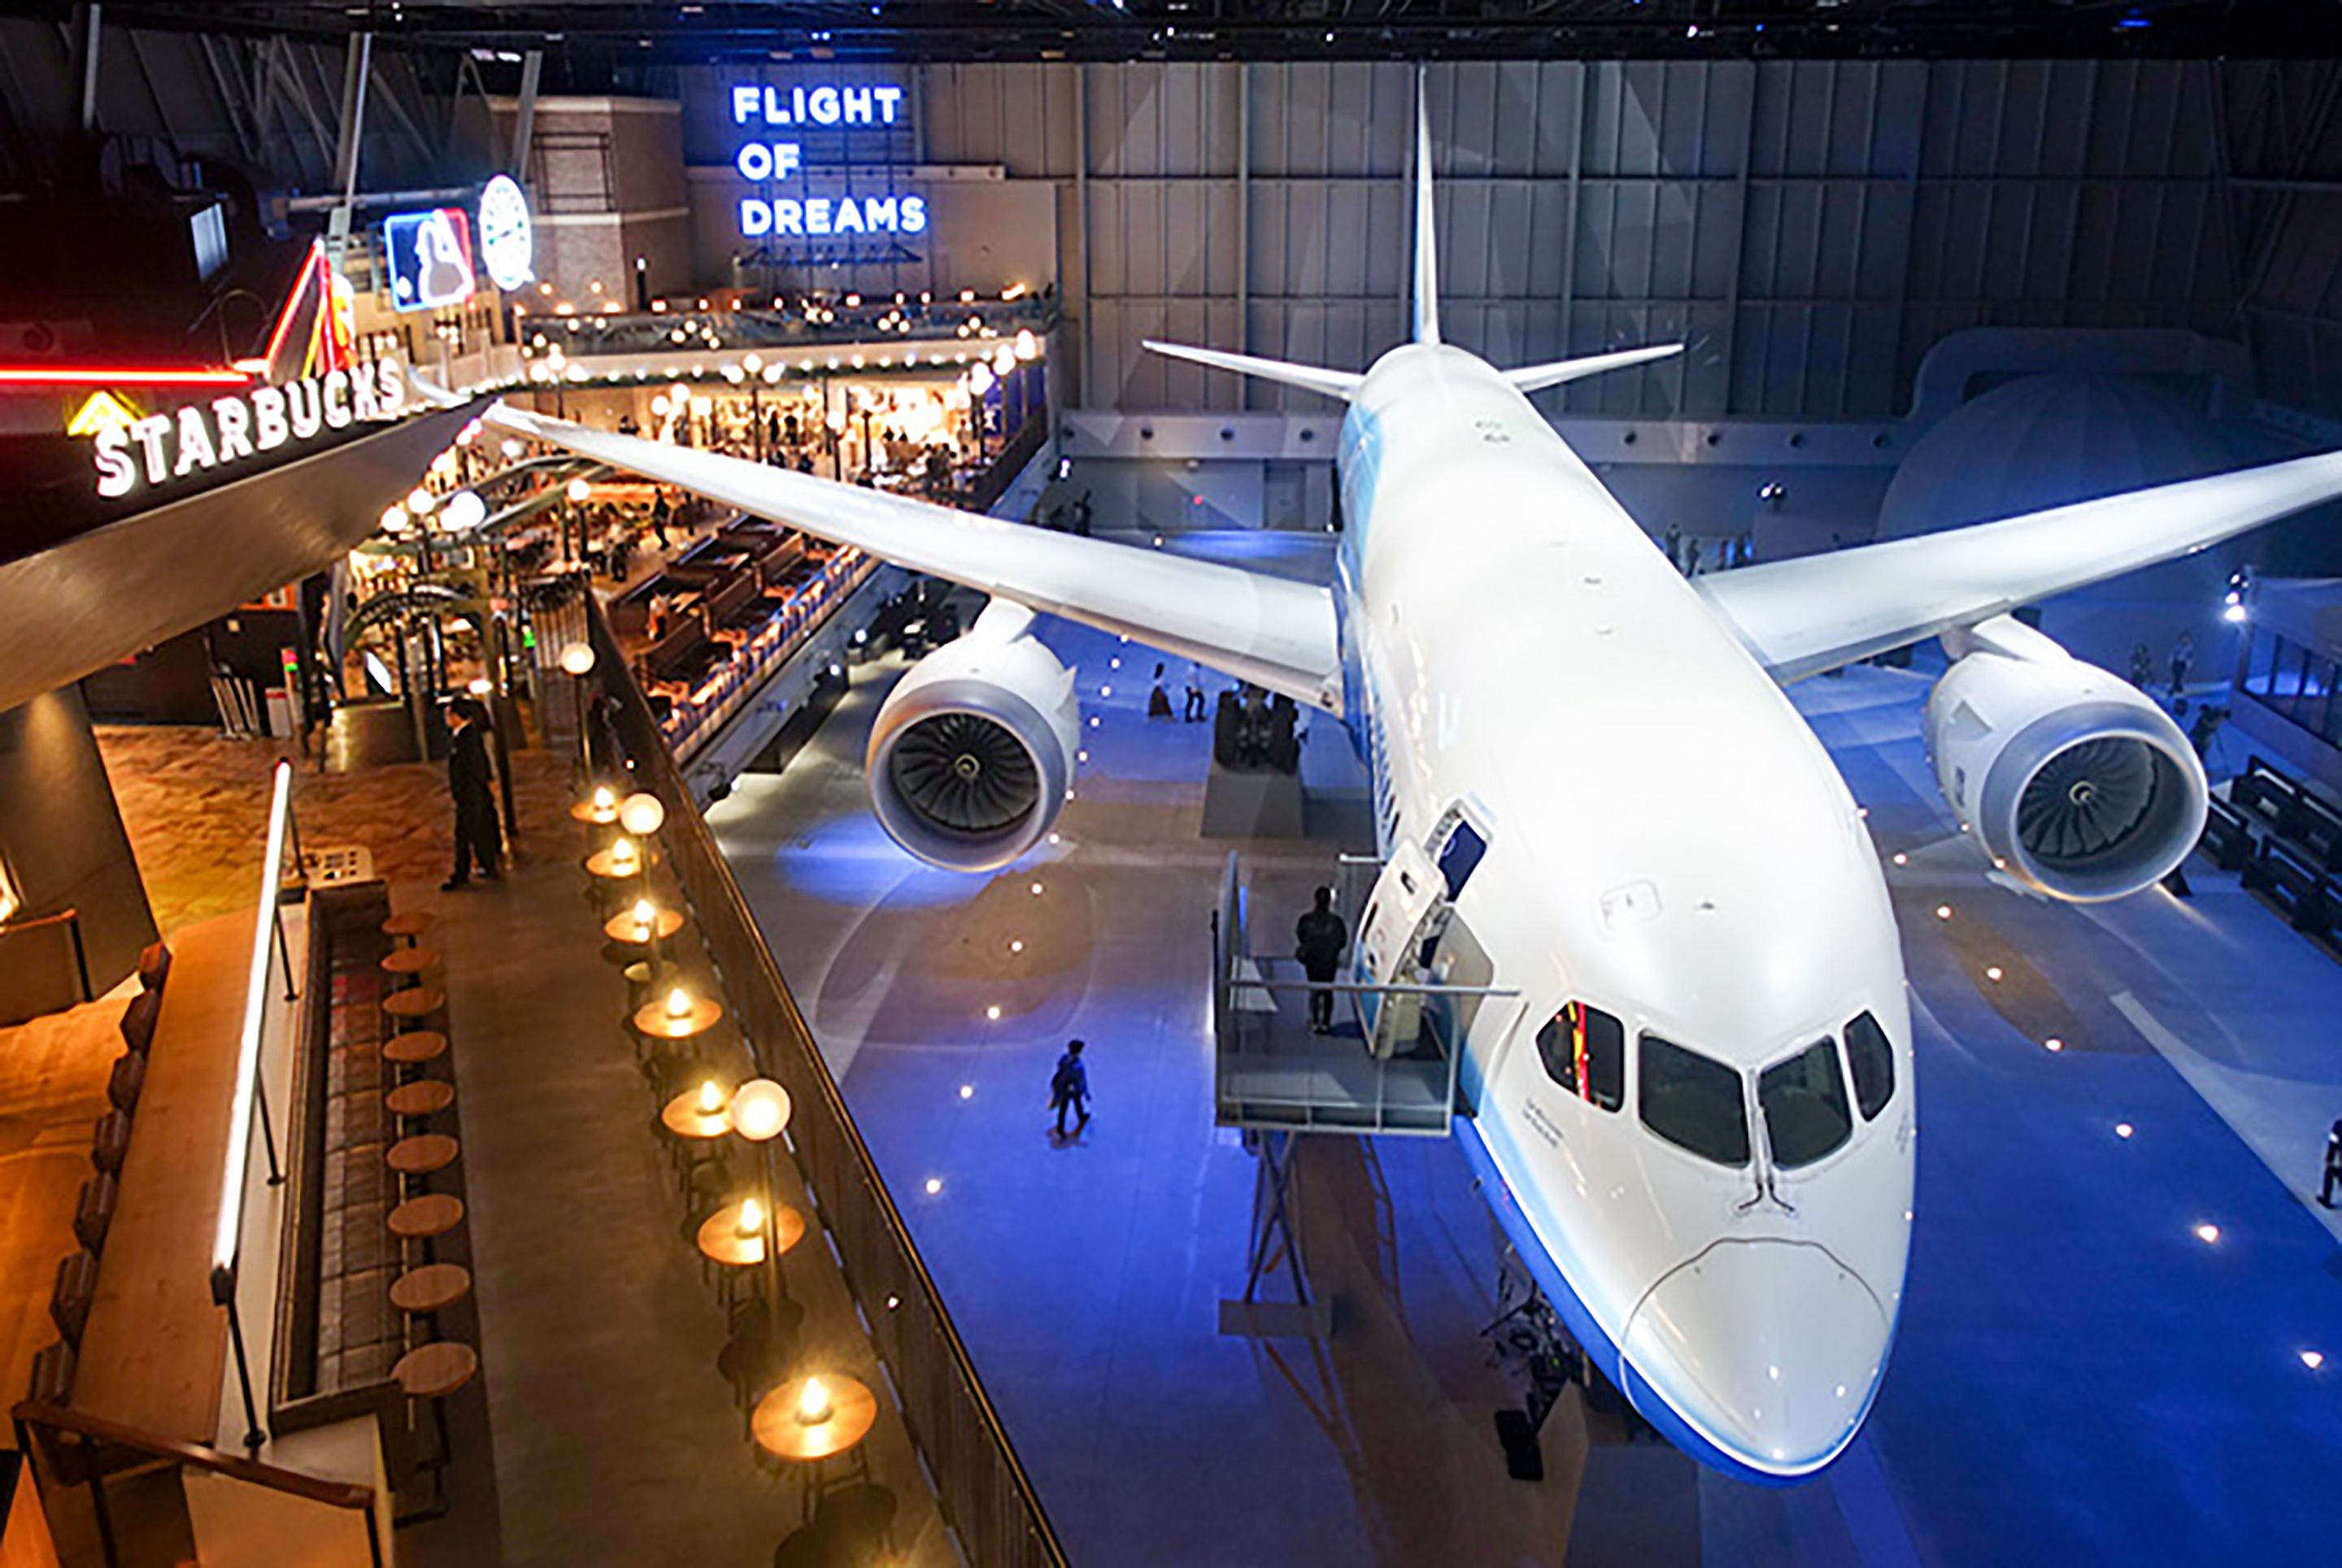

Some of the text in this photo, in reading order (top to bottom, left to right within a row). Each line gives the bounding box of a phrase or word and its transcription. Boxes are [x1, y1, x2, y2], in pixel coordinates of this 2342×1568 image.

[733, 86, 901, 124] FLIGHT
[738, 142, 800, 181] OF
[741, 196, 925, 235] DREAMS
[94, 357, 405, 498] STARBUCKS
